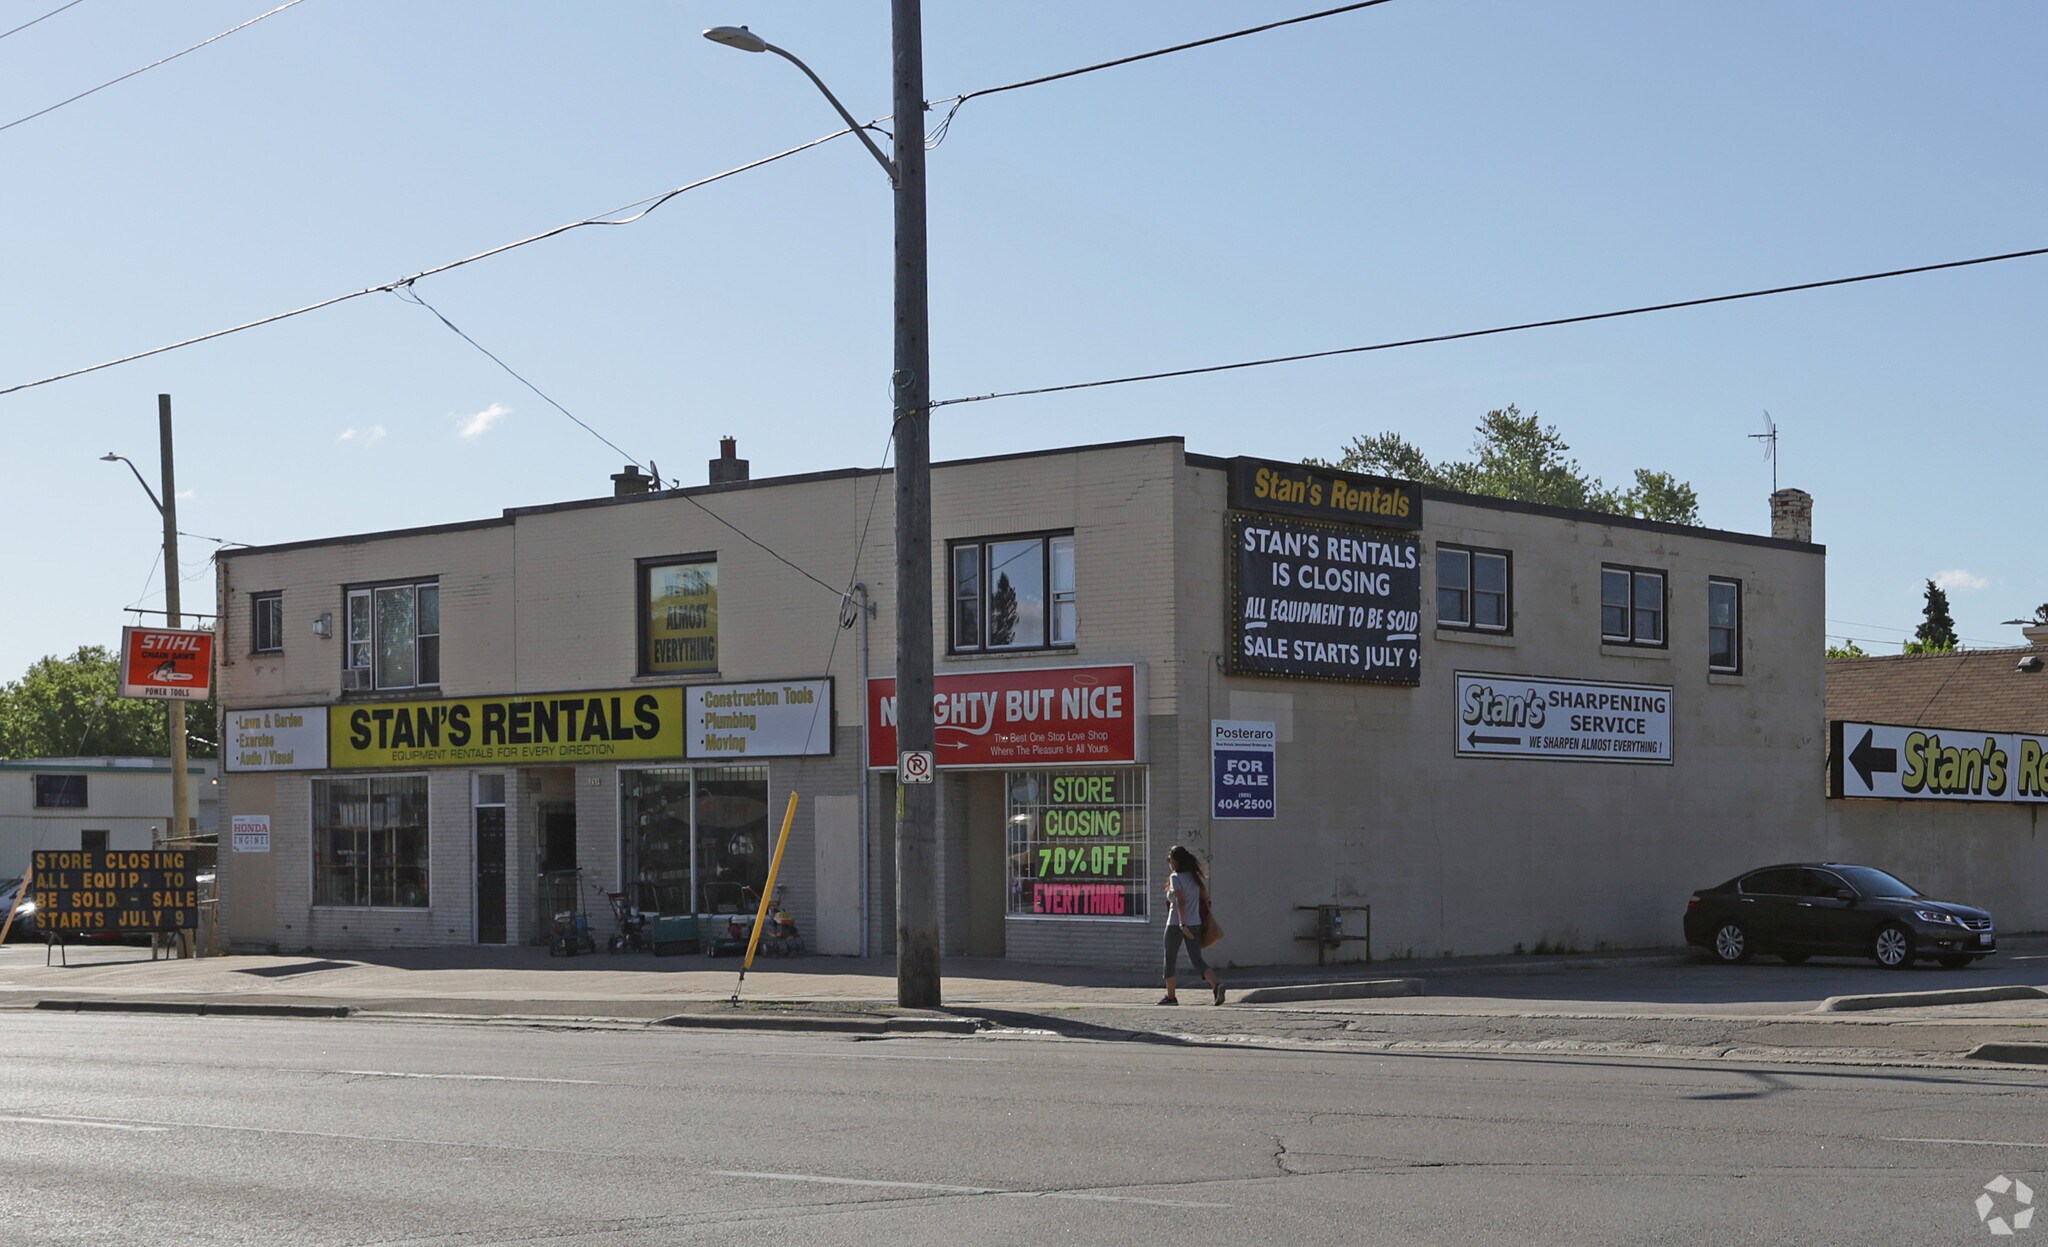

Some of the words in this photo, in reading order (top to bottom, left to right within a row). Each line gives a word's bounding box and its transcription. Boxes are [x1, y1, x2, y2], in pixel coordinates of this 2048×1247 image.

[1254, 467, 1323, 506] Stan's
[1330, 479, 1410, 518] Rentals
[1244, 527, 1320, 559] STAN'S
[1327, 537, 1416, 570] RENTALS
[1272, 562, 1290, 587] IS
[1298, 565, 1390, 596] CLOSING
[666, 604, 709, 631] ALMOST
[1245, 597, 1266, 619] ALL
[1270, 599, 1345, 627] EQUIPMENT
[1349, 606, 1365, 629] TO
[1367, 608, 1384, 630] BE
[1386, 610, 1418, 633] SOLD
[140, 634, 201, 651] STIHL
[654, 636, 716, 663] EVERYTHING
[1244, 635, 1288, 660] SALE
[1293, 640, 1360, 665] STARTS
[1364, 646, 1404, 671] JULY
[1409, 650, 1418, 669] 9
[145, 687, 168, 697] POWER
[171, 688, 190, 697] TOOLS
[704, 689, 779, 708] Construction
[783, 686, 814, 704] Tools
[880, 691, 998, 735] NGHTY
[1005, 689, 1055, 722] BUT
[1061, 685, 1122, 720] NICE
[1463, 683, 1546, 729] Stan's
[1548, 690, 1666, 713] SHARPENING
[239, 715, 262, 730] Lawn
[264, 714, 271, 729] &
[274, 713, 304, 729] Garden
[350, 706, 471, 750] STAN'S
[482, 695, 661, 745] RENTALS
[704, 711, 757, 731] Plumbing
[1570, 714, 1646, 735] SERVICE
[239, 733, 275, 749] Exercise
[994, 733, 1008, 744] The
[1010, 732, 1027, 743] Best
[1029, 731, 1046, 742] One
[1047, 731, 1066, 743] Stop
[1067, 731, 1085, 741] Love
[1088, 729, 1109, 741] Shop
[1215, 727, 1273, 739] Posteraro
[392, 750, 447, 761] EQUIPMENT
[450, 748, 494, 759] RENTALS
[497, 747, 519, 757] FOR
[522, 746, 556, 757] EVERY
[559, 744, 615, 755] DIRECTION
[704, 734, 746, 753] Moving
[990, 745, 1014, 756] Where
[1016, 745, 1031, 755] The
[1032, 744, 1065, 755] Pleasure
[1066, 744, 1073, 754] Is
[1075, 743, 1085, 753] All
[1087, 743, 1109, 754] Yours
[1529, 735, 1542, 748] WE
[1543, 736, 1580, 750] SHARPEN
[1581, 737, 1613, 751] ALMOST
[1613, 739, 1658, 753] EVERYTHING
[239, 752, 262, 766] Audio
[269, 749, 294, 765] Visual
[1227, 759, 1263, 772] FOR
[1901, 731, 2008, 797] Stan's
[1053, 776, 1115, 802] STORE
[1222, 774, 1268, 786] SALE
[1218, 799, 1272, 809] 404-2500
[233, 824, 268, 833] HONDA
[1045, 810, 1120, 836] CLOSING
[233, 836, 269, 845] ENGINES
[36, 853, 93, 869] STORE
[105, 853, 185, 869] CLOSING
[1039, 847, 1087, 877] 70%
[1091, 845, 1130, 876] OFF
[36, 872, 69, 888] ALL
[83, 872, 149, 888] EQUIP.
[163, 872, 185, 887] TO
[36, 892, 58, 908] BE
[72, 892, 116, 908] SOLD
[152, 891, 195, 907] SALE
[1034, 884, 1125, 914] EVERYTHING
[36, 912, 104, 928] STARTS
[118, 911, 161, 926] JULY
[174, 911, 185, 926] 9
